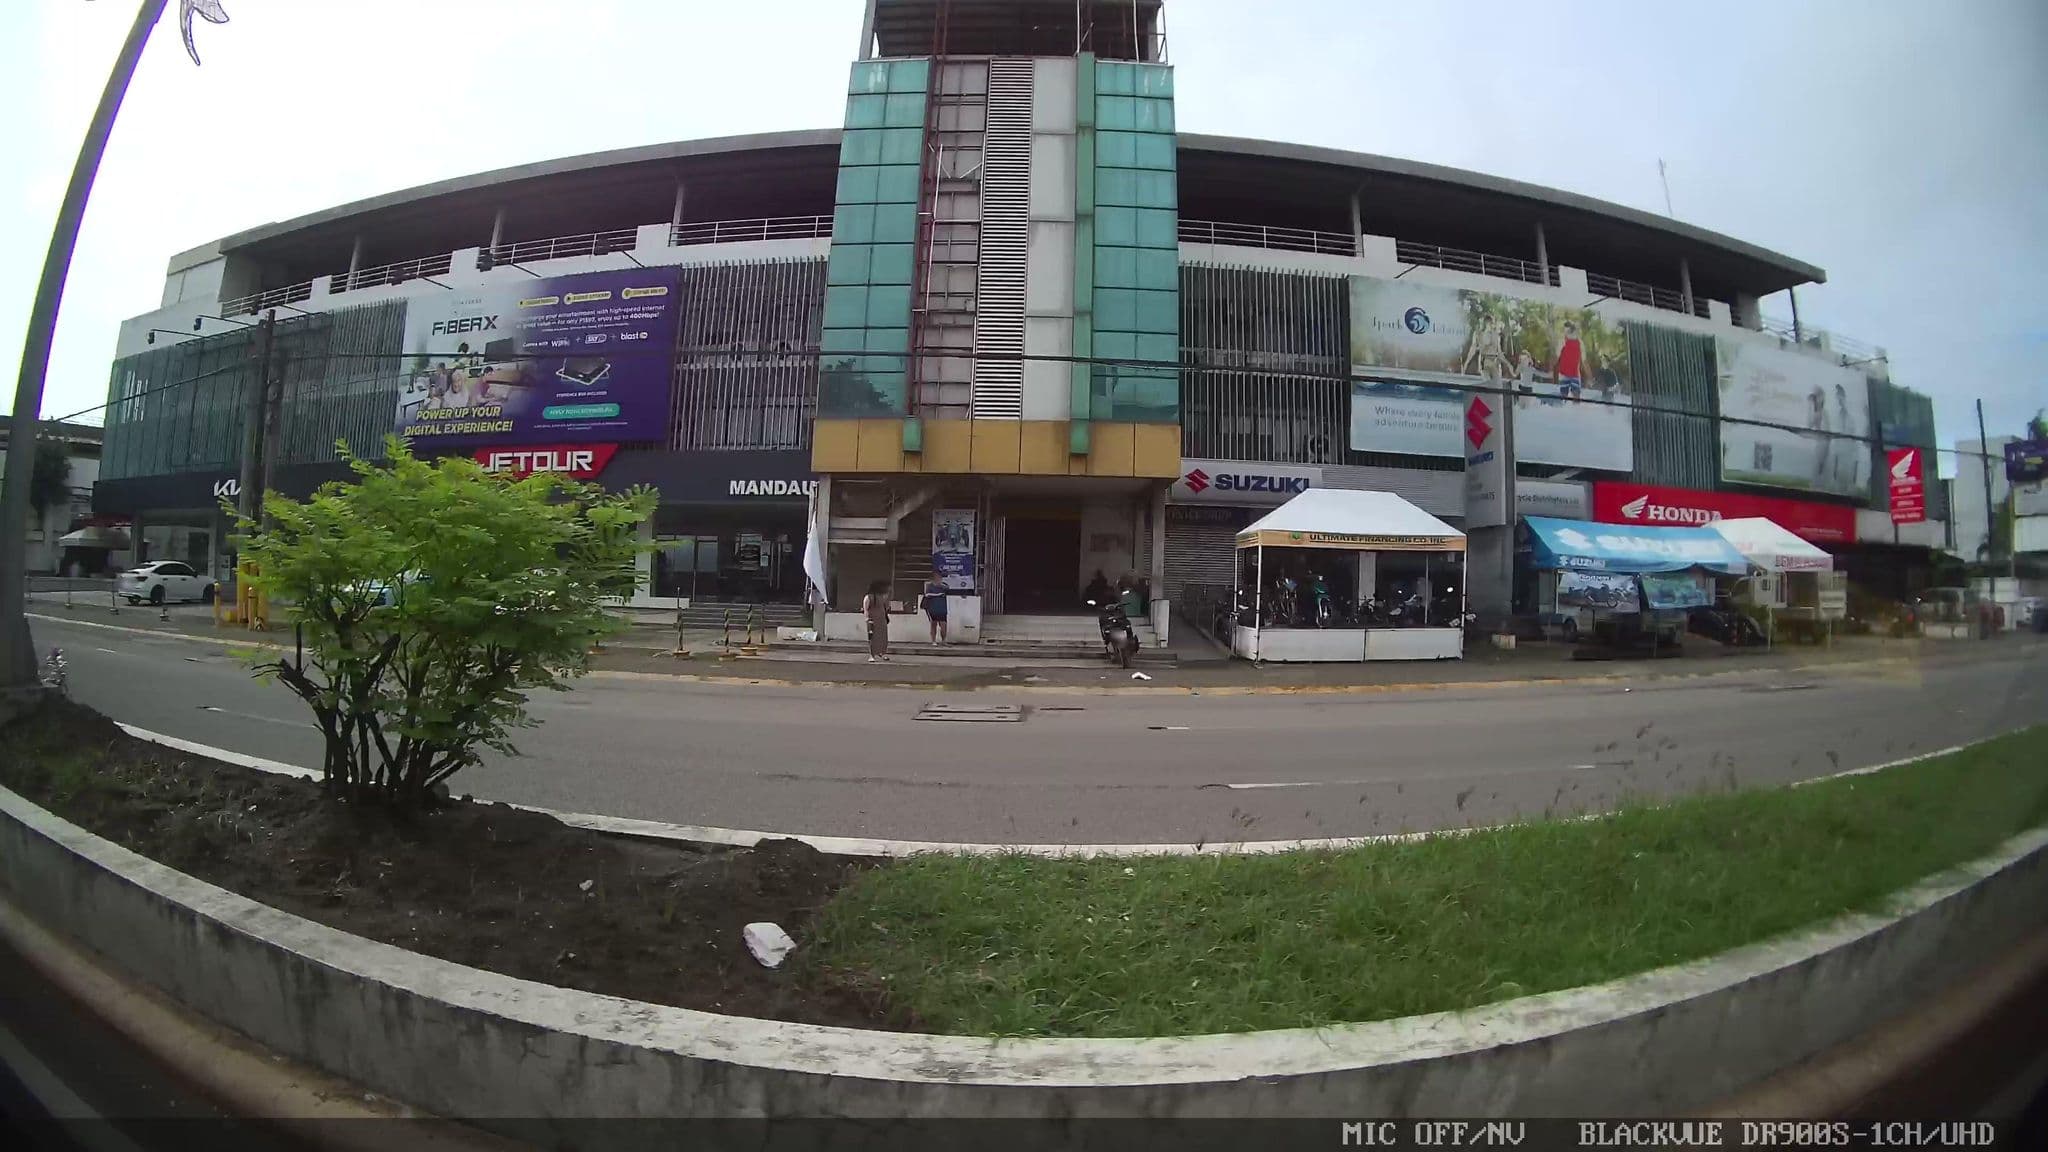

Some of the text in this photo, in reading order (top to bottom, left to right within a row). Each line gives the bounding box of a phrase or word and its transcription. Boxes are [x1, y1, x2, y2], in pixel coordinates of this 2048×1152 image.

[416, 405, 501, 421] POWER UP YOUR
[404, 420, 514, 437] DIGITAL EXPERIENCE!
[484, 450, 593, 473] JETOUR
[1215, 473, 1310, 493] SUZUKI
[1648, 504, 1723, 524] HONDA
[1309, 533, 1359, 542] ULTIMATE
[1360, 535, 1412, 543] FINANCING
